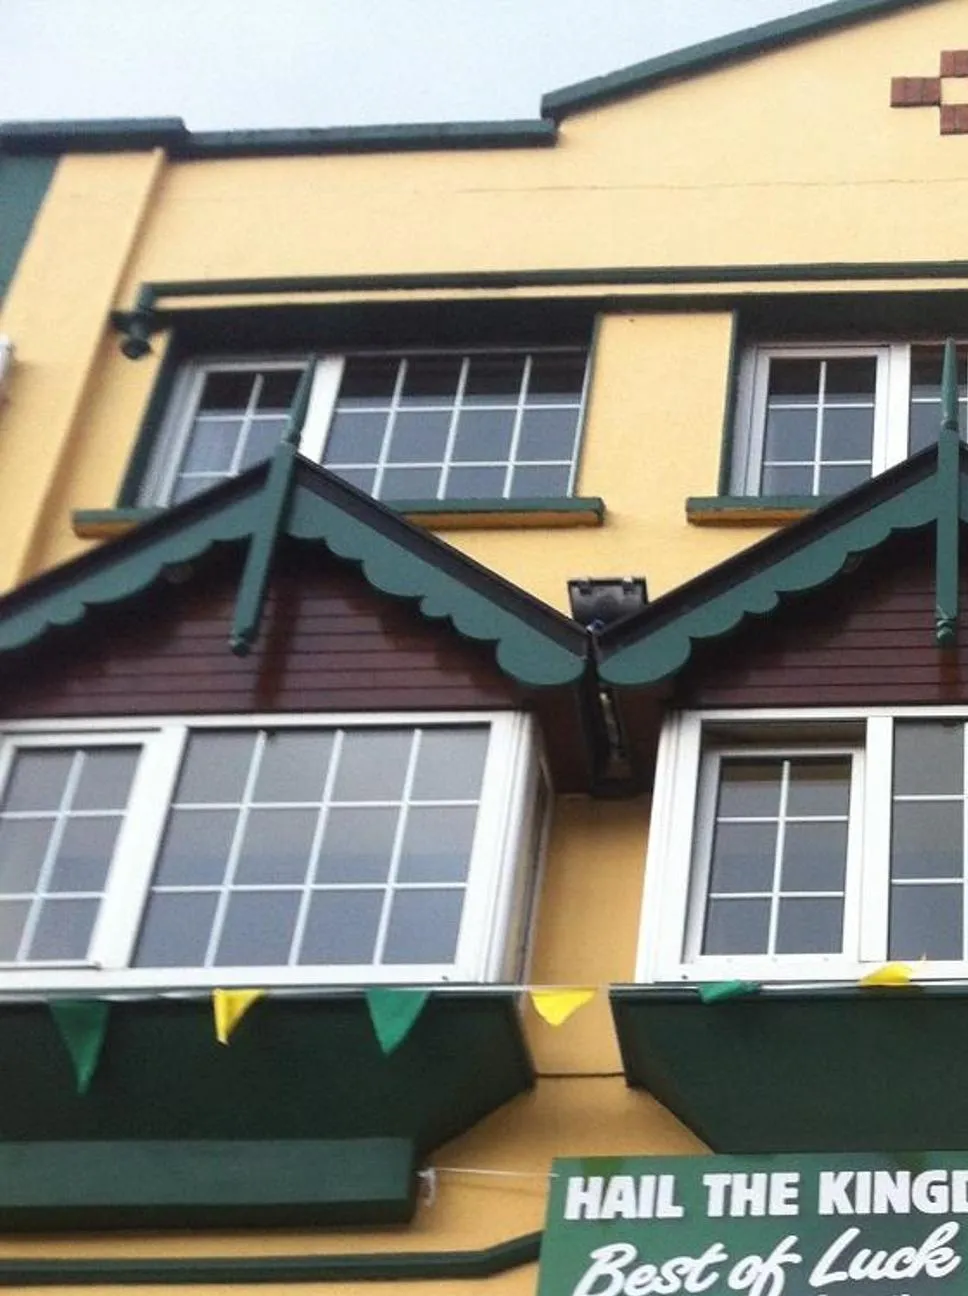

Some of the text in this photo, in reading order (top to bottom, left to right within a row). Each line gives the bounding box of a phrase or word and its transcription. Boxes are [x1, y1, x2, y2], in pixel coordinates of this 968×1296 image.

[564, 1175, 684, 1220] HAIL
[703, 1172, 799, 1218] THE
[809, 1221, 961, 1286] Luck
